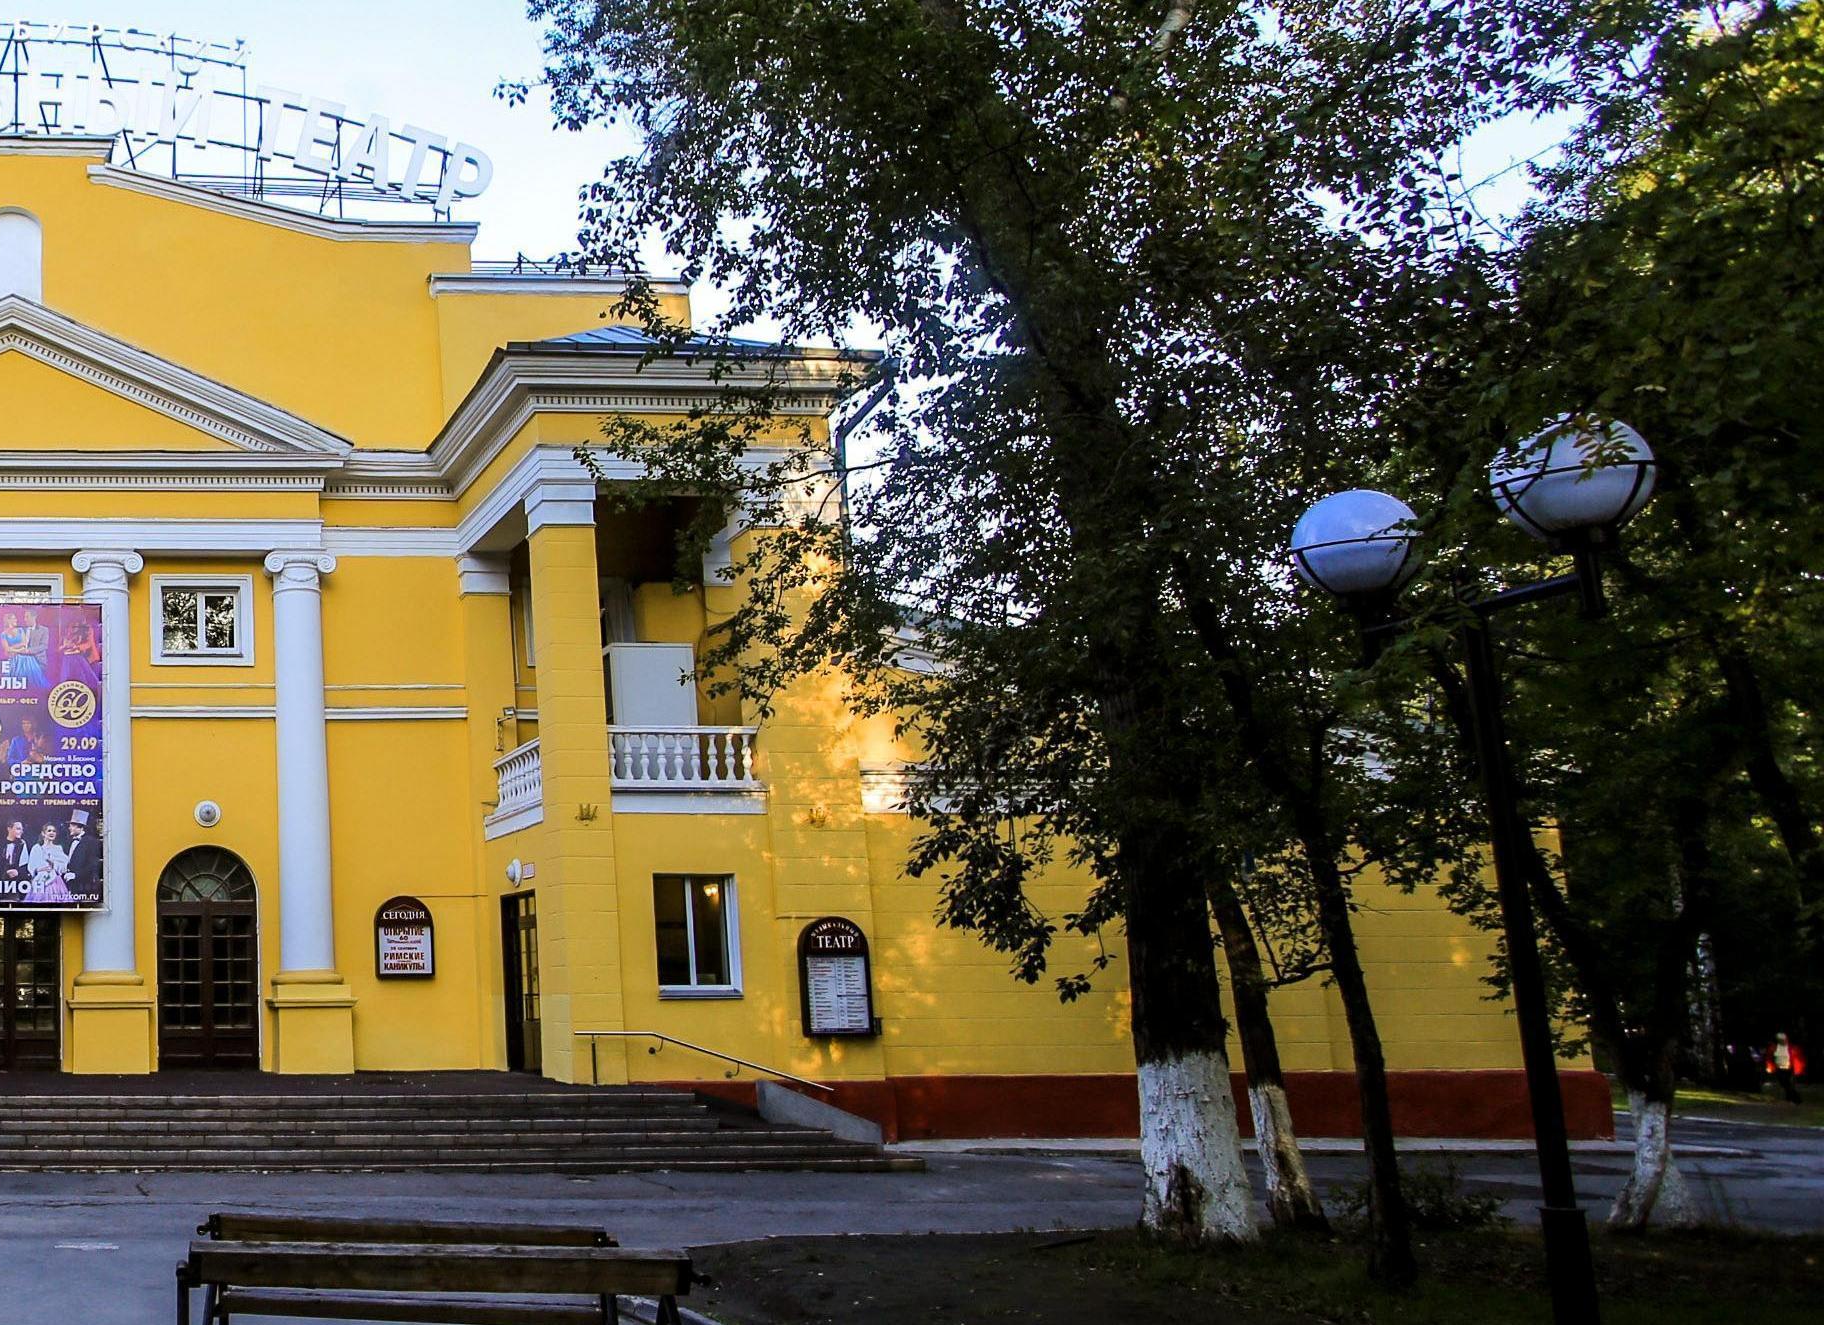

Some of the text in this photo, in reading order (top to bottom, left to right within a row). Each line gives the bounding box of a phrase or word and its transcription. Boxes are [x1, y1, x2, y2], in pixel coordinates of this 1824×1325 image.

[256, 85, 494, 214] ТЕАТР
[61, 737, 97, 750] 29.09
[10, 764, 96, 778] СРЕДСТВО
[51, 891, 99, 901] muzkom.ru
[383, 911, 425, 920] СЕГОДНЯ
[816, 935, 855, 948] ТЕАТР
[384, 952, 425, 960] РИМСКИЕ
